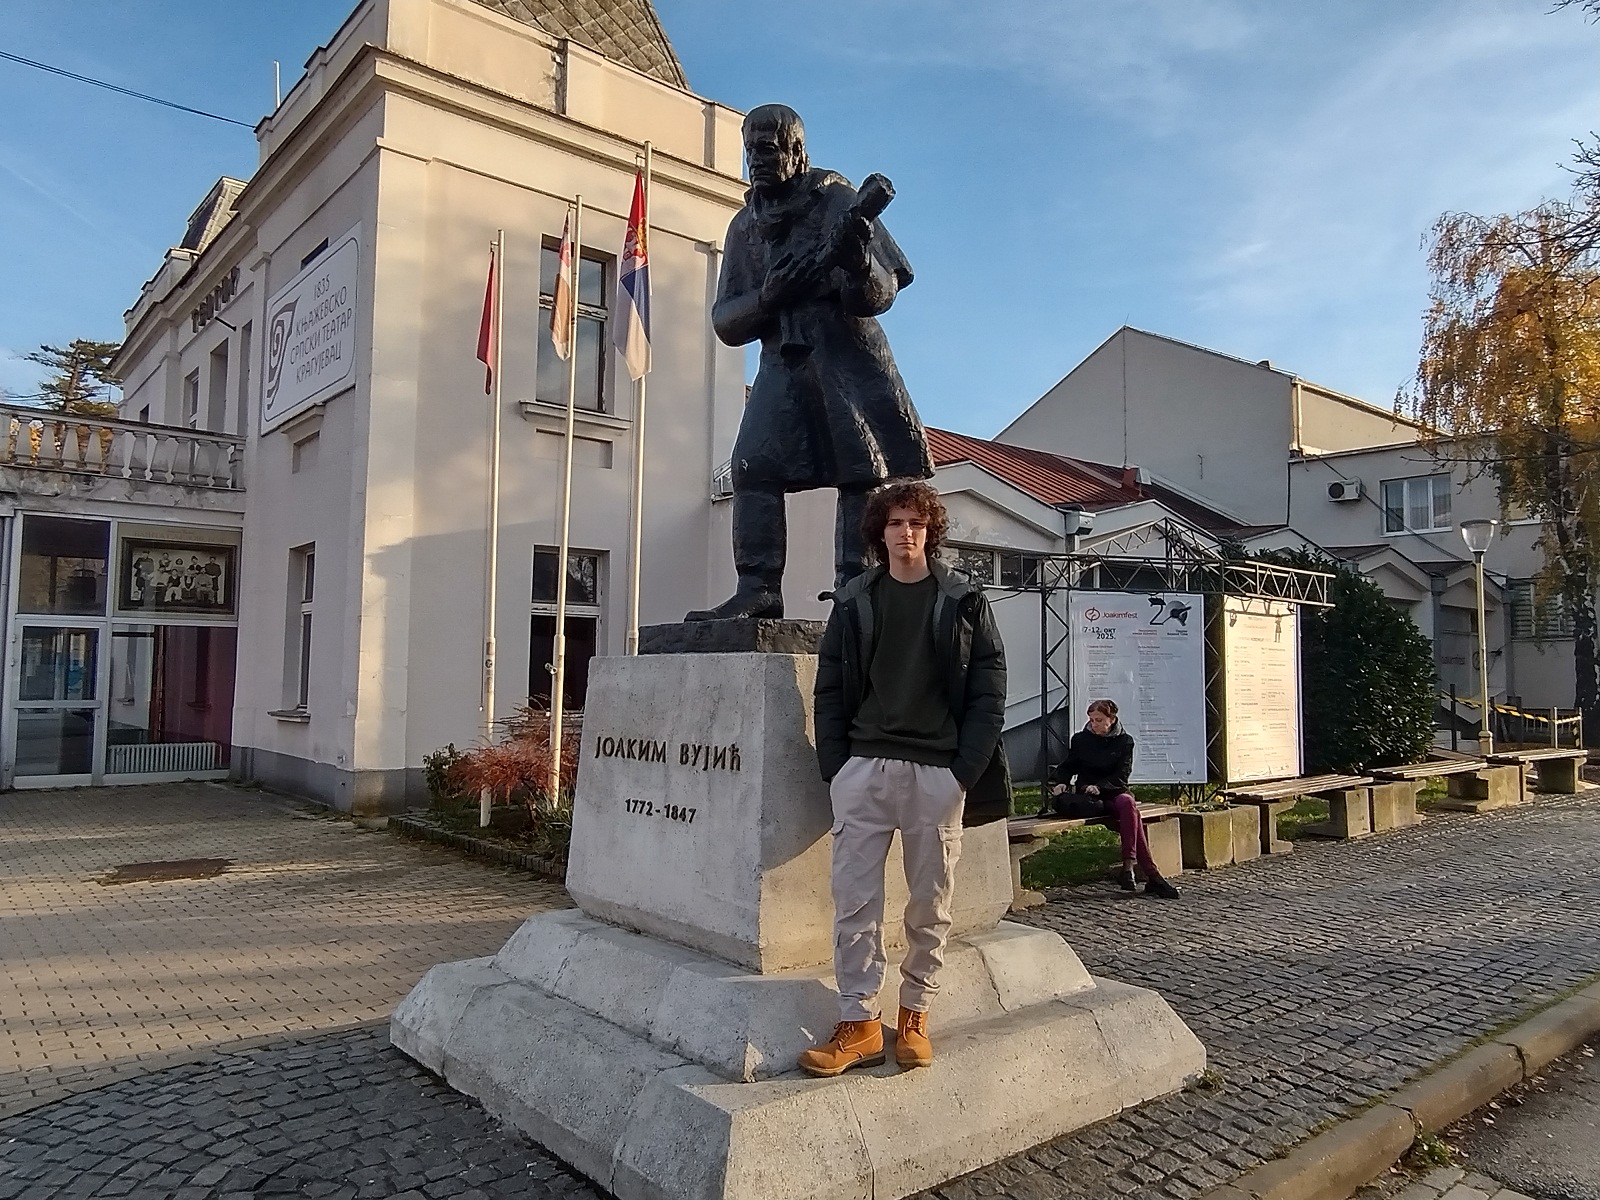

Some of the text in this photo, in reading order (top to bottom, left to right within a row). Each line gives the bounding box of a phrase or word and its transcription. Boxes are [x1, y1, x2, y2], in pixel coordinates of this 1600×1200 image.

[313, 274, 330, 301] 1835
[295, 286, 347, 337] КЊАЖЕВСКО
[290, 307, 353, 365] СРПСКИ ТЕАТАР
[295, 341, 342, 384] КРАГУЈЕВАЦ
[1102, 611, 1138, 620] Joakimfest
[594, 736, 741, 771] ЈОАКИМ ВУЈИЋ
[625, 798, 697, 824] 1772-1847
